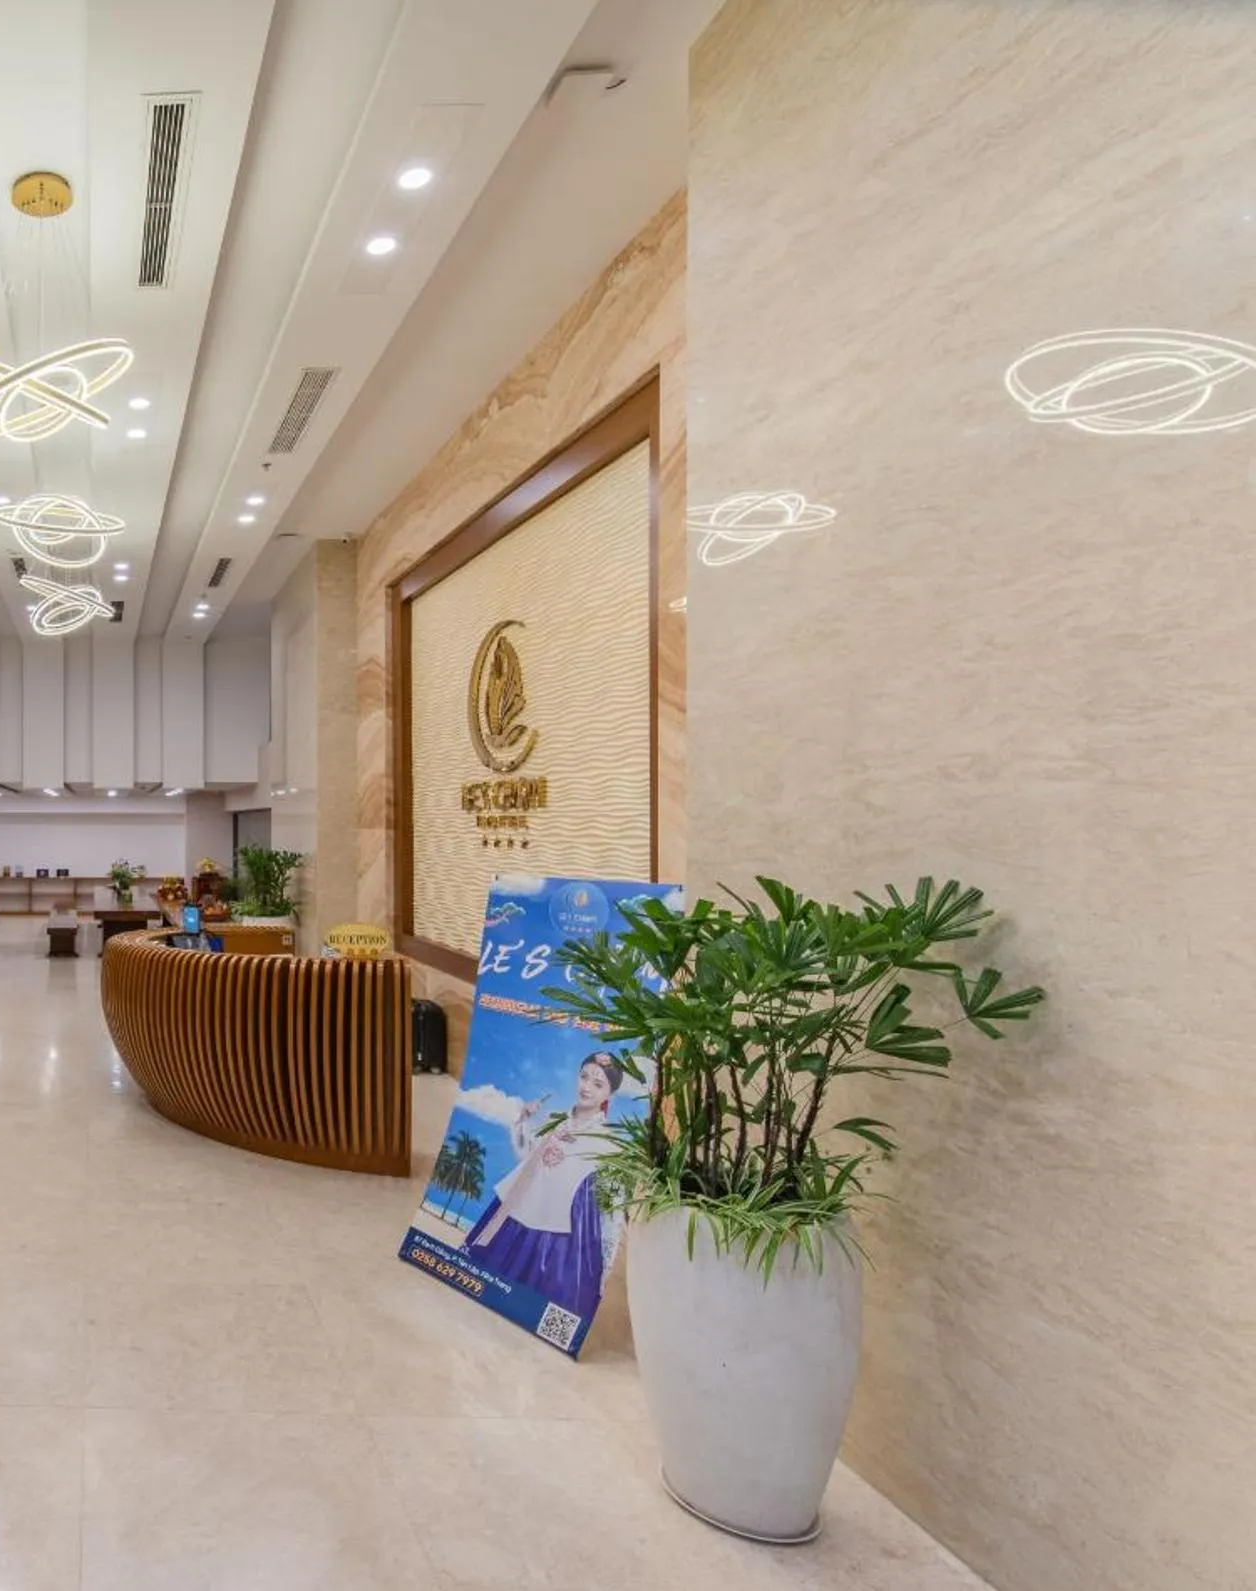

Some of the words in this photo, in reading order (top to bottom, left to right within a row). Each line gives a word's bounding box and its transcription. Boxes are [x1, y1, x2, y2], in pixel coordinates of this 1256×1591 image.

[328, 934, 387, 945] RECEPTION
[436, 1263, 456, 1278] 629
[455, 1271, 483, 1293] 7979
